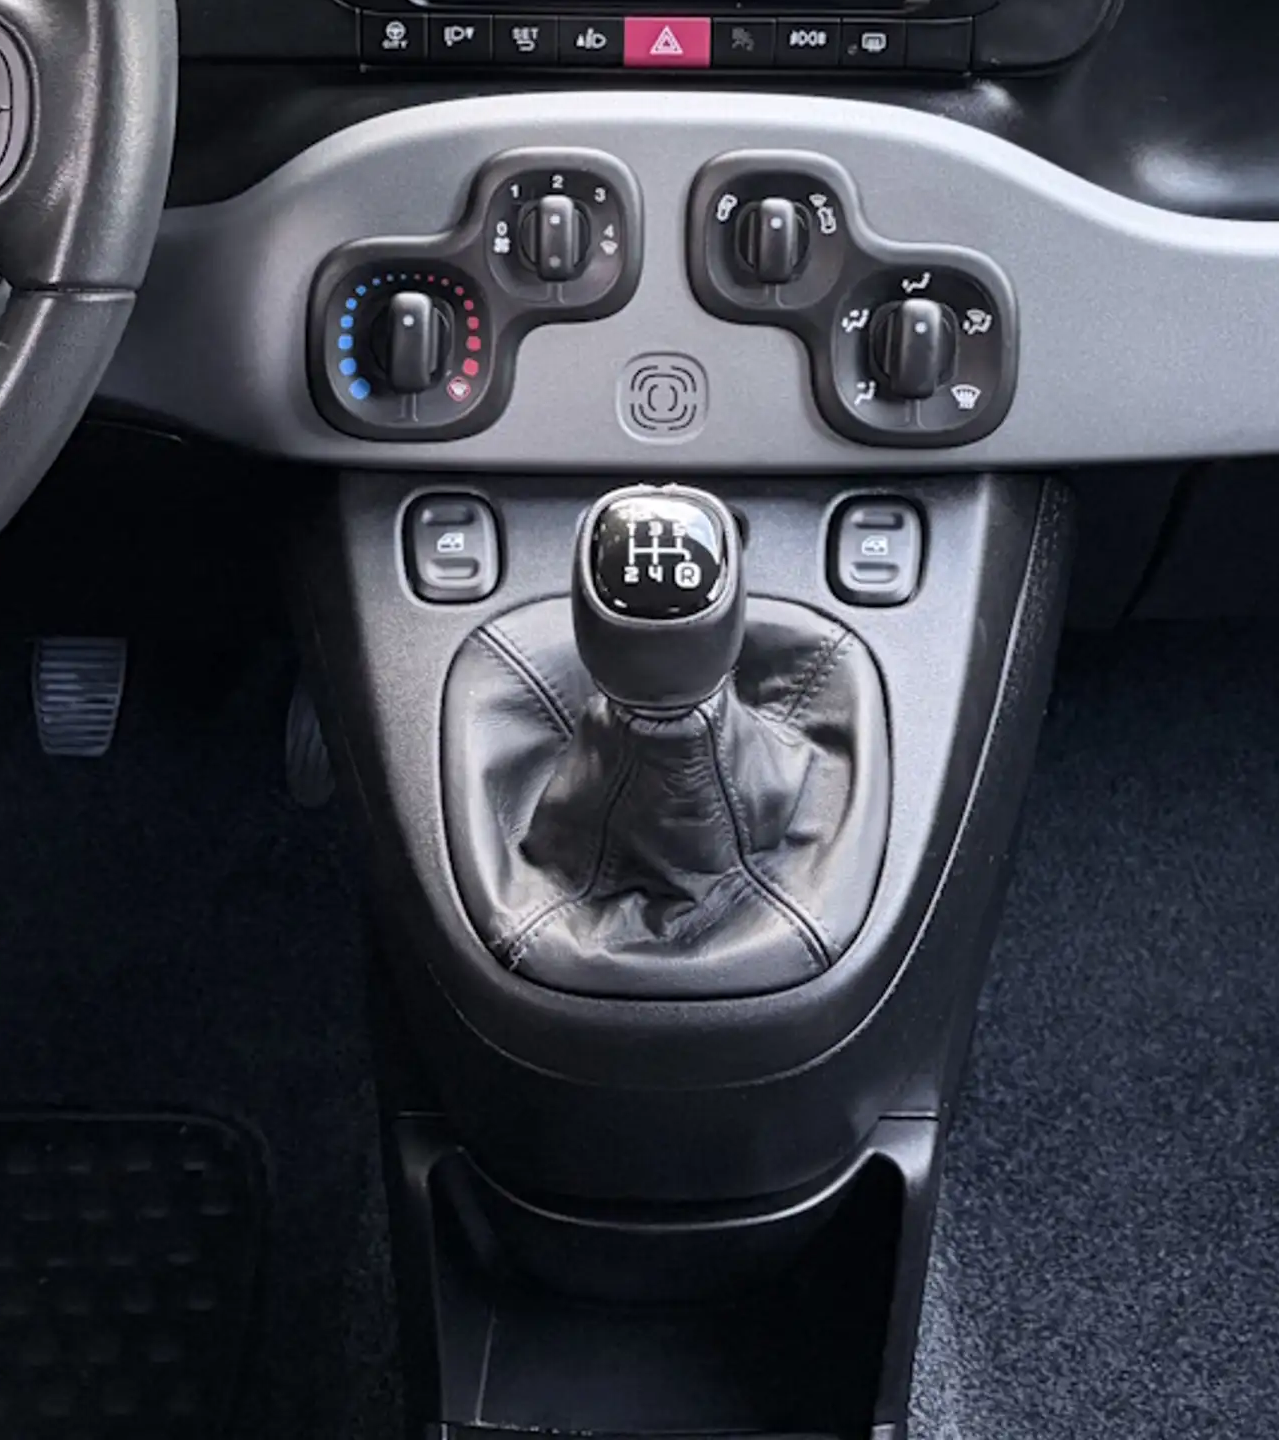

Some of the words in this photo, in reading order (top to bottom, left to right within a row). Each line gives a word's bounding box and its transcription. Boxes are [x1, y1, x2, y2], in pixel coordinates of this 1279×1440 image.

[512, 27, 539, 40] SET
[552, 174, 564, 189] 2
[510, 184, 519, 198] 1
[594, 187, 606, 202] 3
[496, 221, 508, 236] 0
[603, 224, 615, 238] 4
[624, 566, 639, 583] 2
[648, 565, 663, 582] 4
